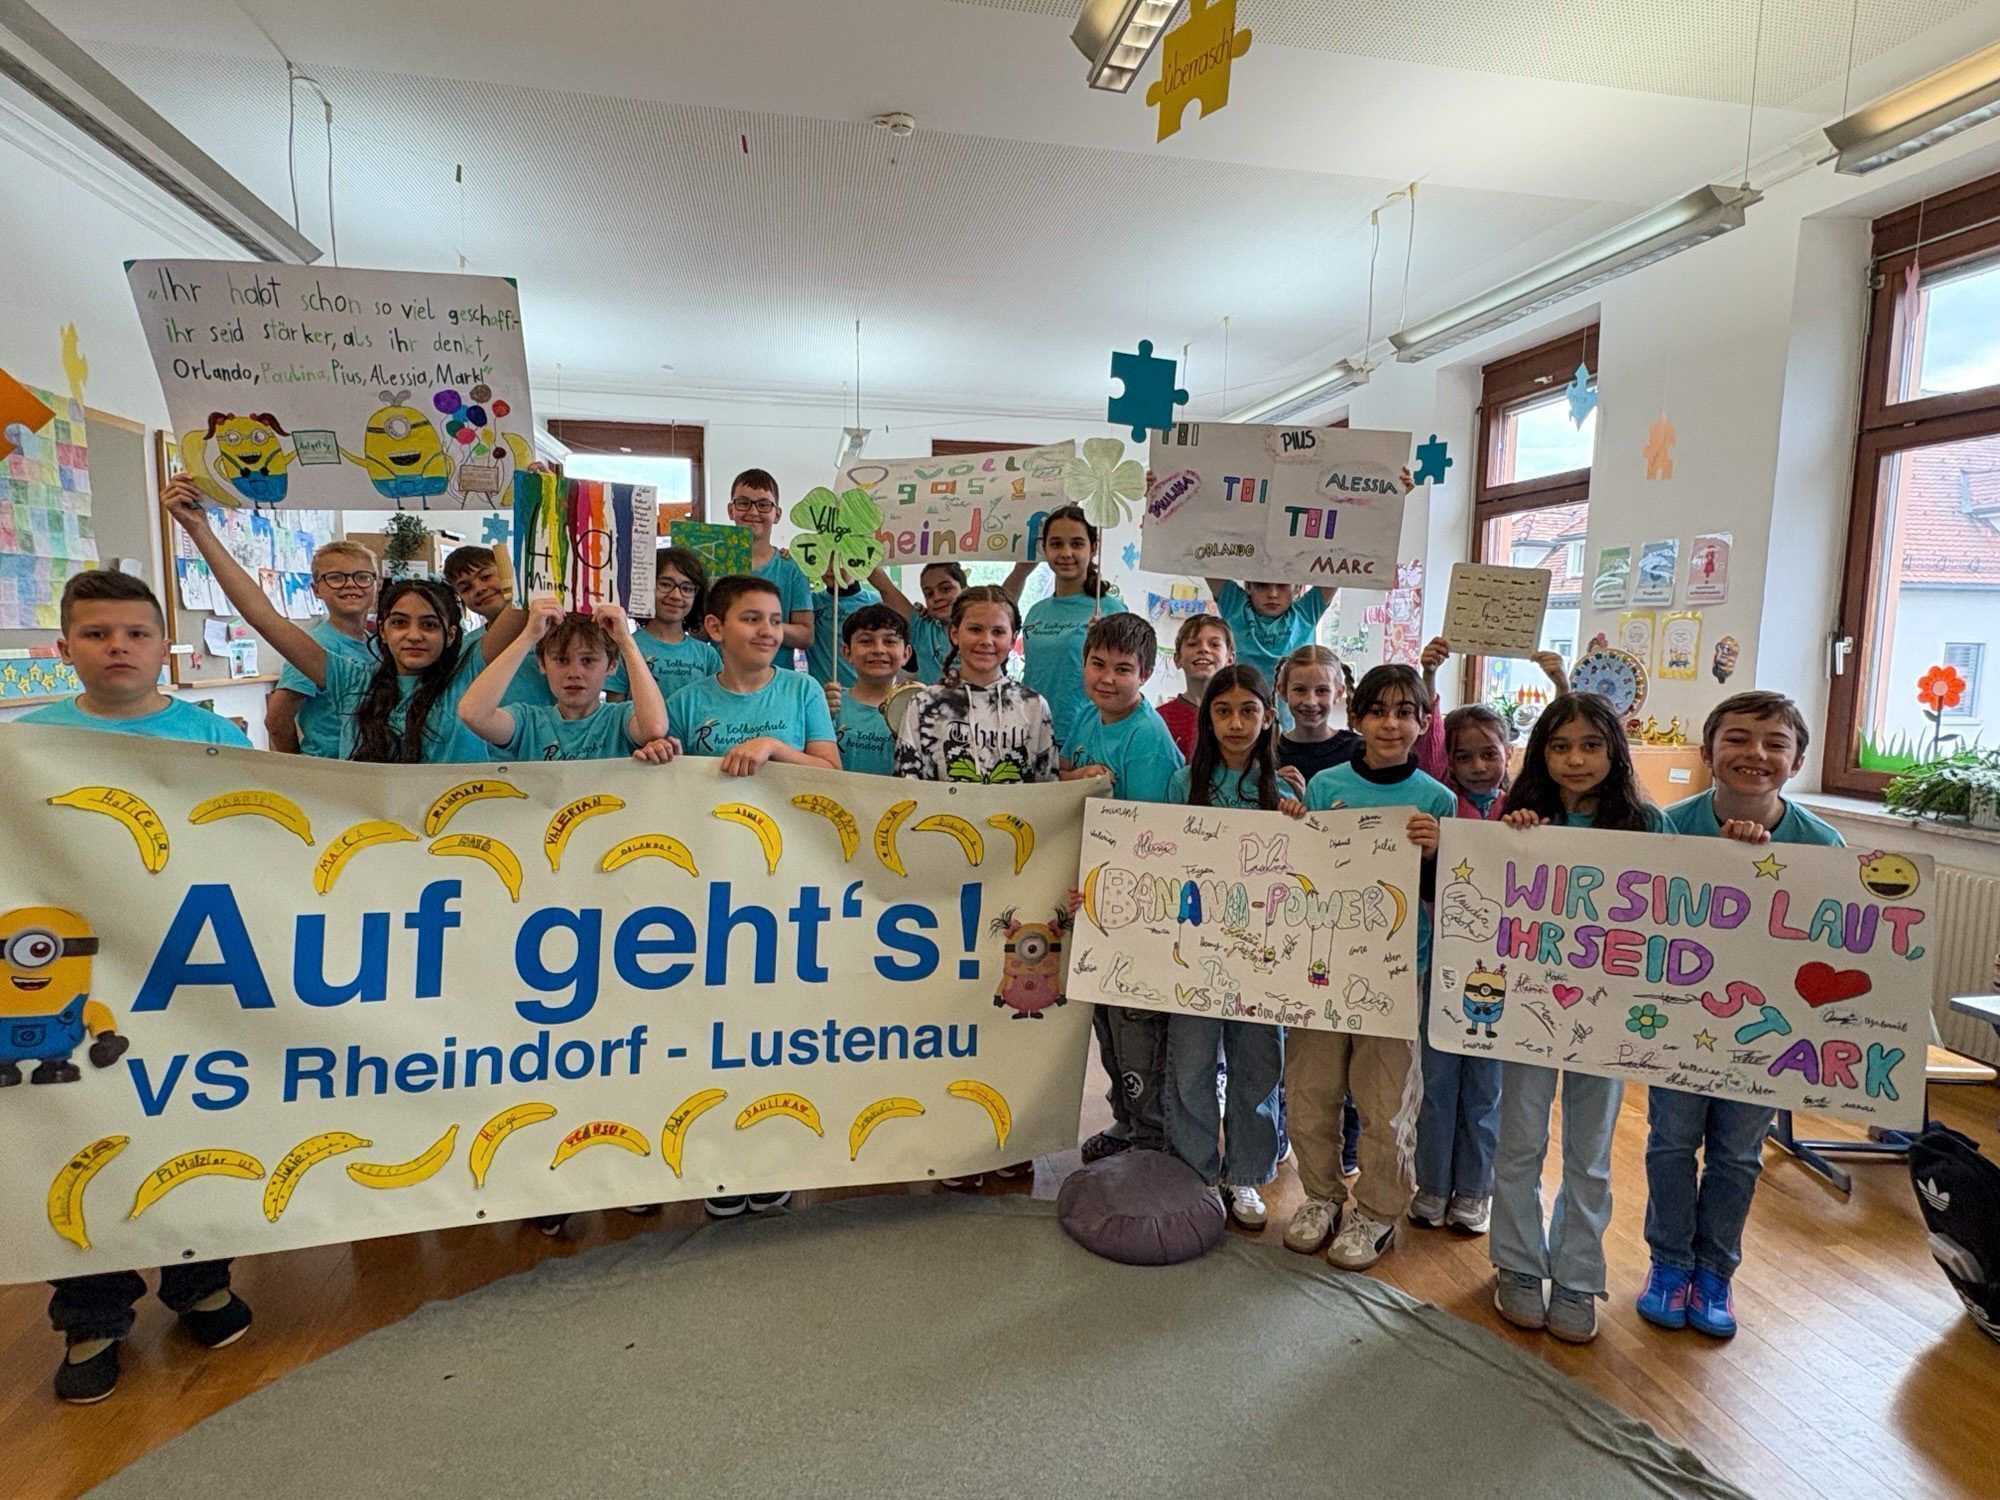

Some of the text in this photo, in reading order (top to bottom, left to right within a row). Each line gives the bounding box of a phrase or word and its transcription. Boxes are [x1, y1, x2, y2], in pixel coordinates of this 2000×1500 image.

[227, 272, 281, 308] habt
[301, 280, 361, 312] schon
[375, 301, 392, 315] so
[401, 297, 435, 320] viel
[165, 317, 490, 362] ihr seid stärker, als ihr denkt,
[173, 358, 260, 386] Orlando,
[331, 358, 368, 387] Pius,
[369, 363, 434, 388] Alessia,
[1280, 430, 1316, 452] PIUS
[1223, 476, 1268, 503] TOI
[1325, 472, 1398, 495] ALESSIA
[874, 507, 1050, 561] heindorf
[1285, 505, 1338, 539] TOI
[1194, 543, 1255, 560] ORLANDO
[1309, 556, 1375, 575] MARC
[546, 795, 602, 846] VALERIAN
[1505, 860, 1604, 921] WIR
[1608, 870, 1750, 930] SIND
[130, 879, 463, 1013] Auf
[1497, 916, 1714, 986] IHR SEID
[1701, 980, 1905, 1102] STARK
[127, 1049, 250, 1117] VS
[283, 1025, 648, 1103] Rheindorf
[711, 1020, 979, 1070] Lustenau
[744, 1097, 800, 1119] PAULINA
